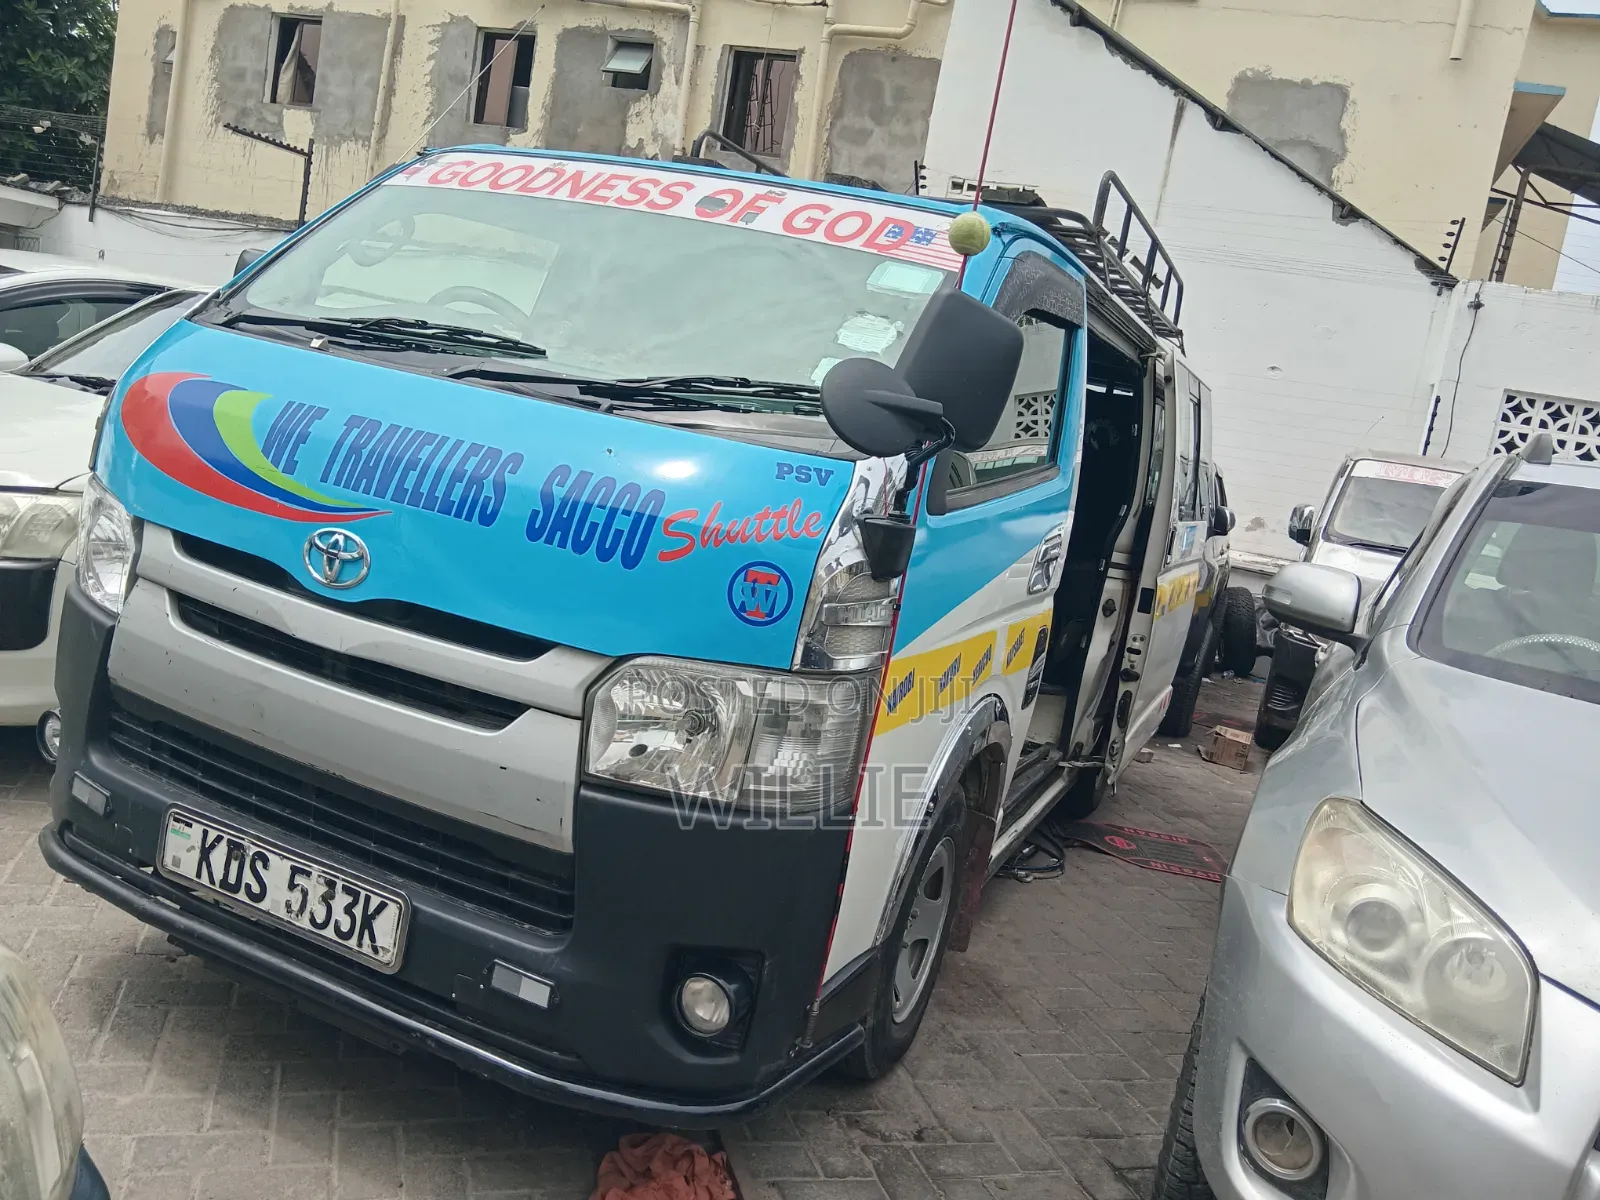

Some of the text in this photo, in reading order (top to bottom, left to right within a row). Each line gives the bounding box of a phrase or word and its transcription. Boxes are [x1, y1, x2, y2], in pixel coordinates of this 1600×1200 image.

[427, 160, 916, 254] GOODNESS OF GOD
[261, 400, 667, 571] WE TRAVELLERS SACCO
[775, 462, 834, 487] PSV
[657, 497, 826, 563] Shuttle
[886, 667, 916, 716] NAIROBI
[1123, 826, 1189, 844] NISSAN
[195, 827, 270, 904] KDS
[284, 864, 390, 956] 533K
[1149, 861, 1221, 880] NISSAN
